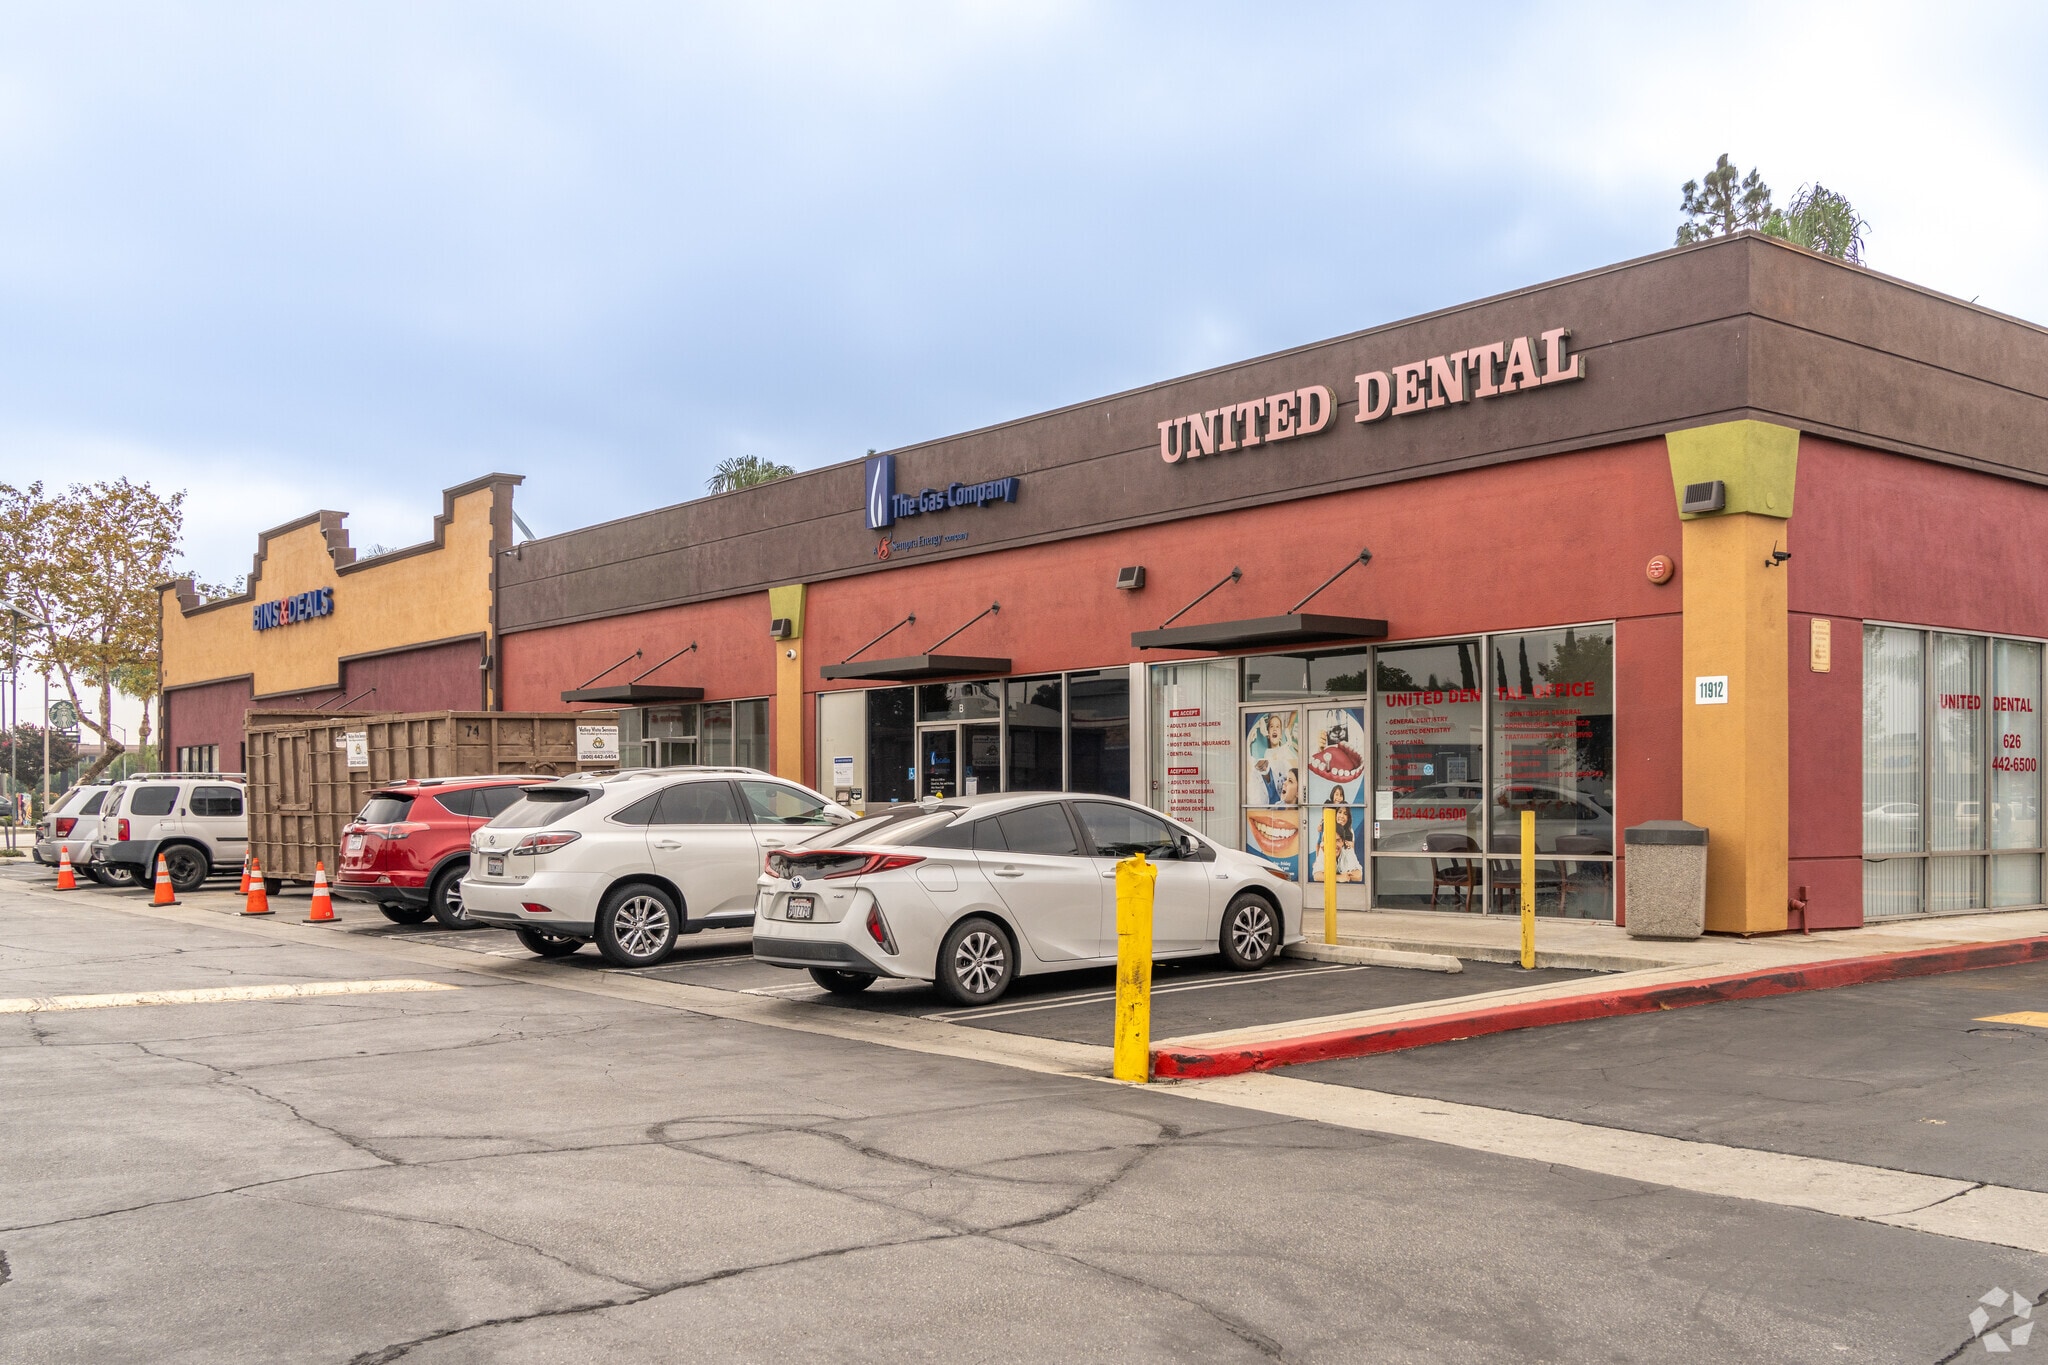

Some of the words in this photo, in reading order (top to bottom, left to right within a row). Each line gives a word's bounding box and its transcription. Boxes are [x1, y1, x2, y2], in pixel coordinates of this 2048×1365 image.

[1157, 384, 1336, 463] UNITED
[1354, 327, 1586, 424] DENTAL
[892, 493, 918, 518] The
[919, 488, 945, 513] Gas
[947, 477, 1020, 508] Company
[891, 540, 918, 552] Sempra
[919, 535, 943, 547] Energy
[944, 532, 969, 542] company
[253, 586, 334, 631] BINS&DEALS
[1301, 672, 1307, 689] A
[1386, 690, 1443, 707] UNITED
[1532, 681, 1595, 699] OFFICE
[1699, 681, 1724, 699] 11912
[959, 703, 964, 713] B
[1940, 693, 1981, 710] UNITED
[1993, 696, 2033, 712] DENTAL
[1416, 716, 1448, 724] DENTISTRY
[465, 725, 479, 738] 74
[2003, 734, 2021, 749] 626
[1992, 756, 2037, 772] 442-6500
[1392, 807, 1467, 820] 626-442-6500
